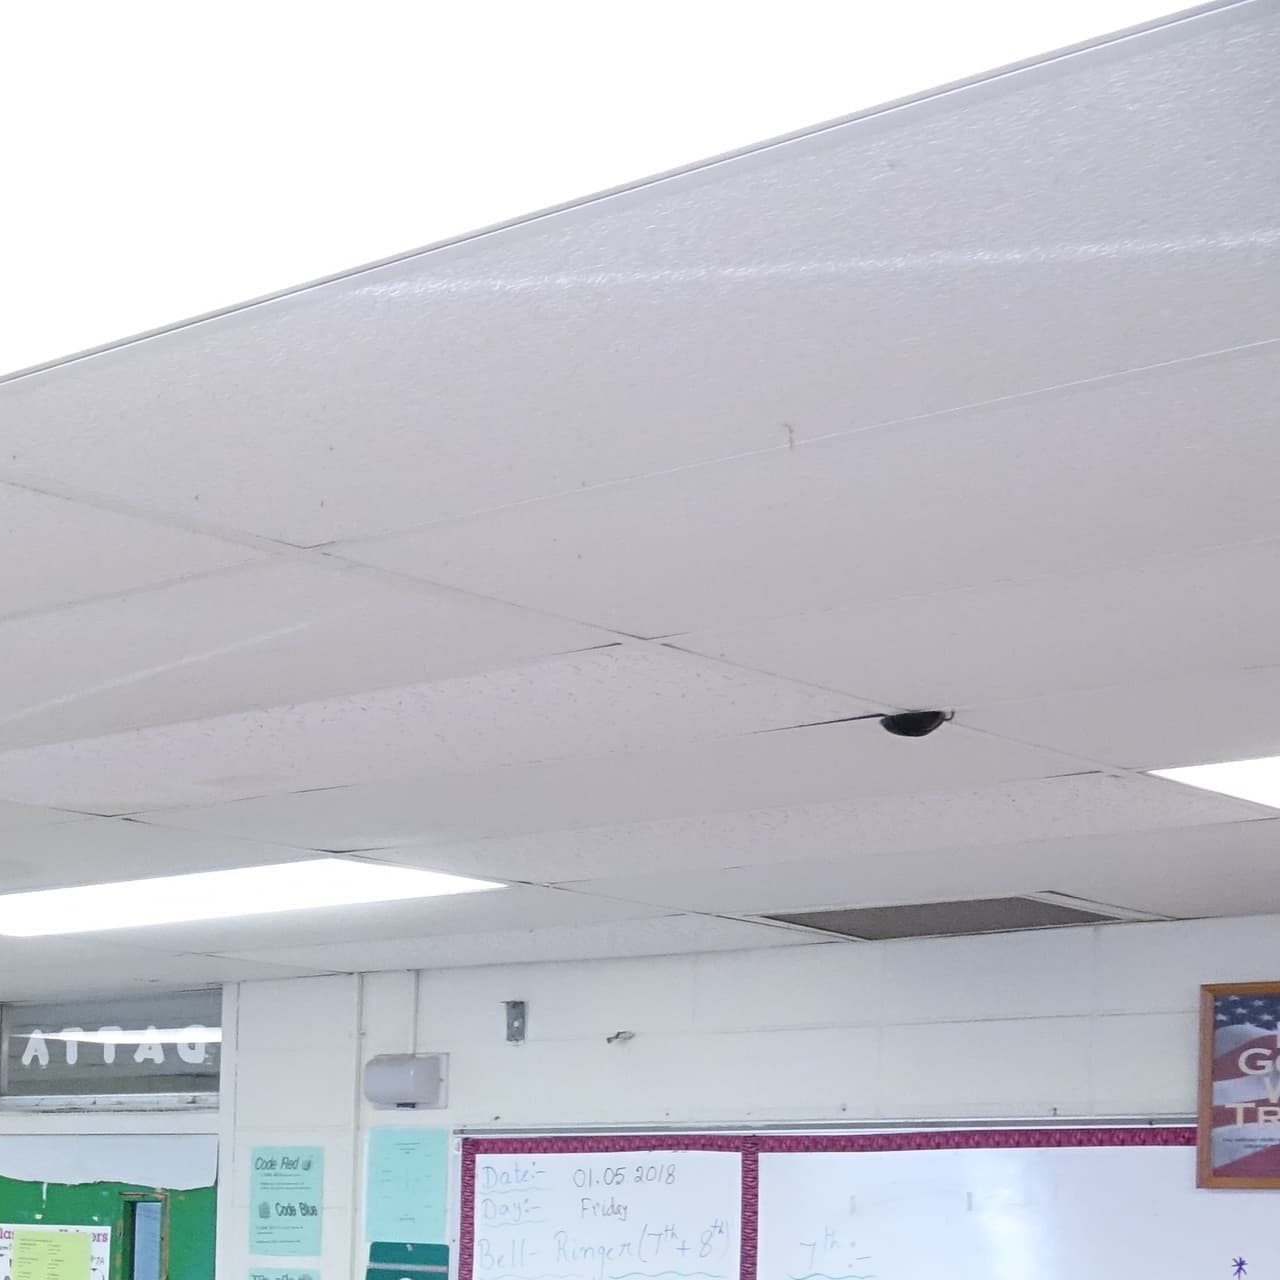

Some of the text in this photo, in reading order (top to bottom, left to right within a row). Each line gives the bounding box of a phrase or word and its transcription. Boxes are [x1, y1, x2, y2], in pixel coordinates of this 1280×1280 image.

[1238, 1047, 1280, 1075] G
[255, 1156, 300, 1170] Code Red
[275, 1202, 318, 1216] Code Blue
[581, 1197, 628, 1221] Friday
